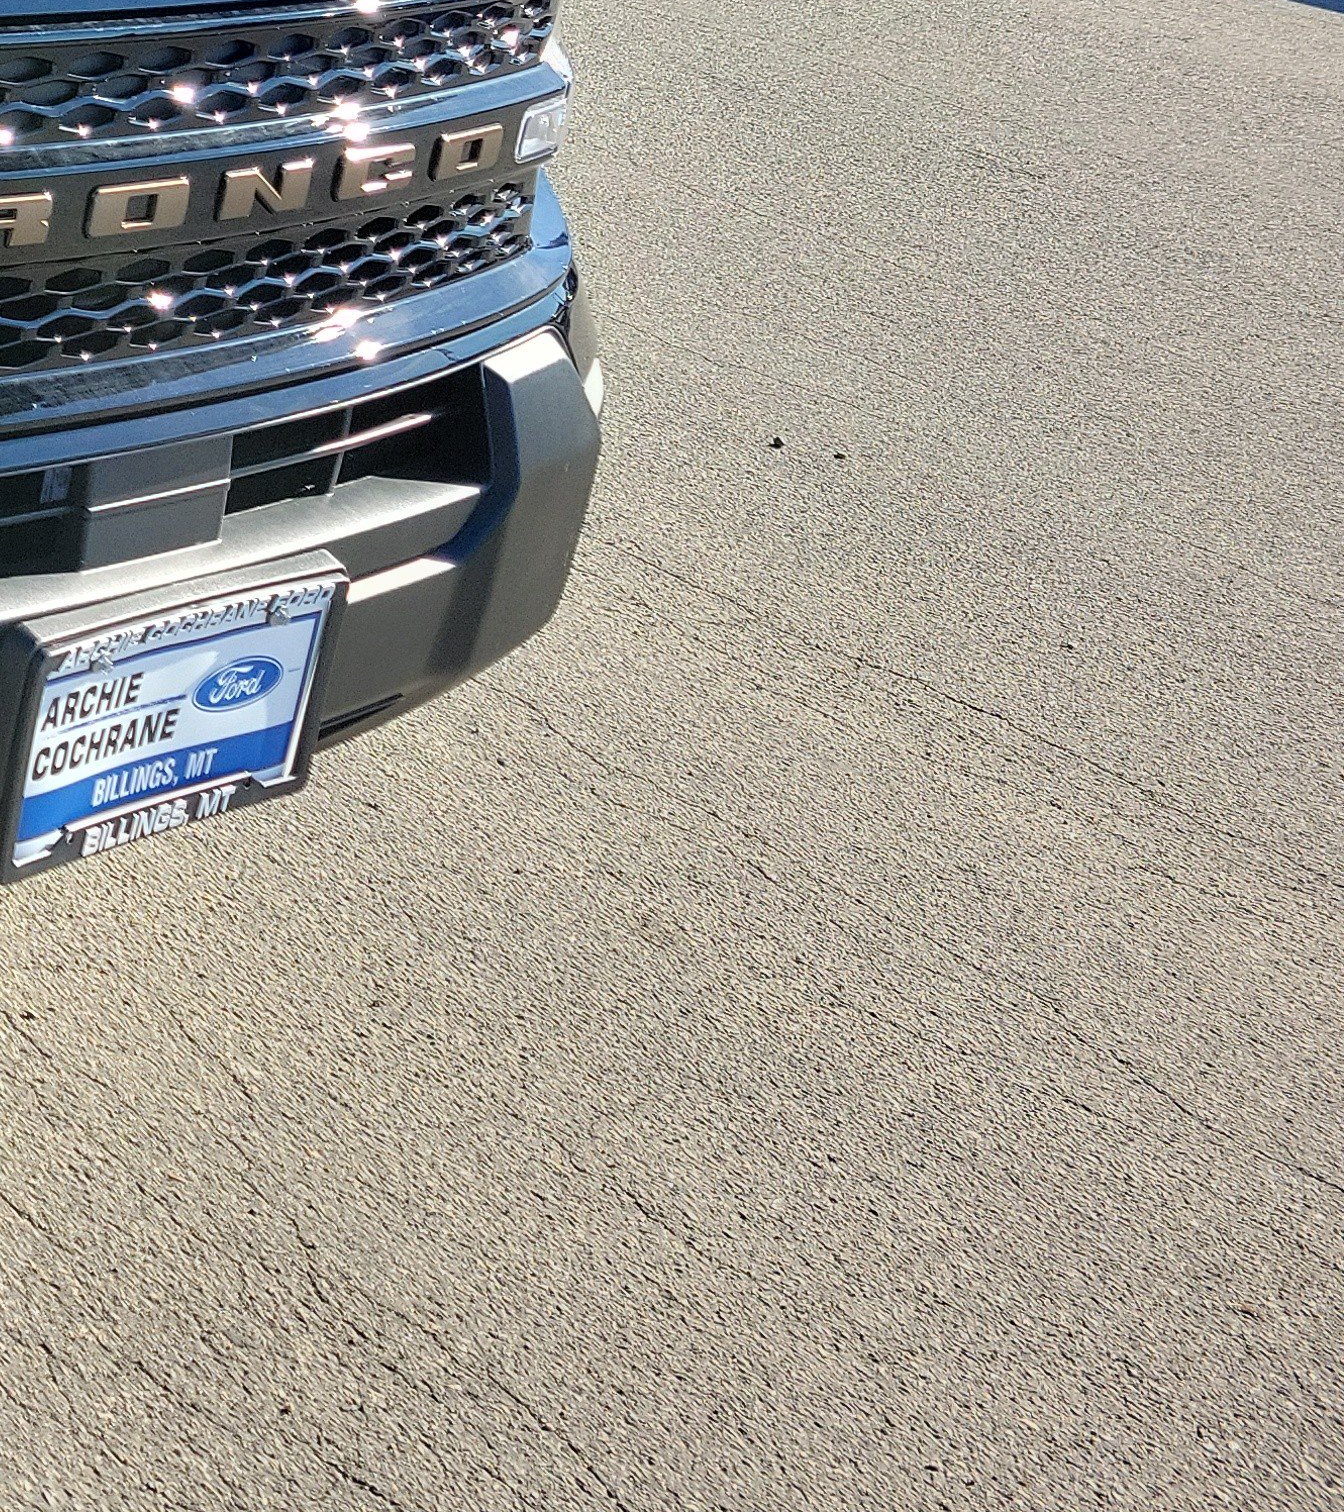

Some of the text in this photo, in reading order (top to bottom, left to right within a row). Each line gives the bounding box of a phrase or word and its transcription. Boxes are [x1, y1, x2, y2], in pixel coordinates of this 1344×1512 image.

[41, 672, 145, 732] ARCHIE
[209, 664, 262, 705] Ford
[31, 707, 180, 781] COCHRANE
[91, 748, 218, 807] BILLINGS, MT
[81, 786, 236, 857] BILLINGS, MT
